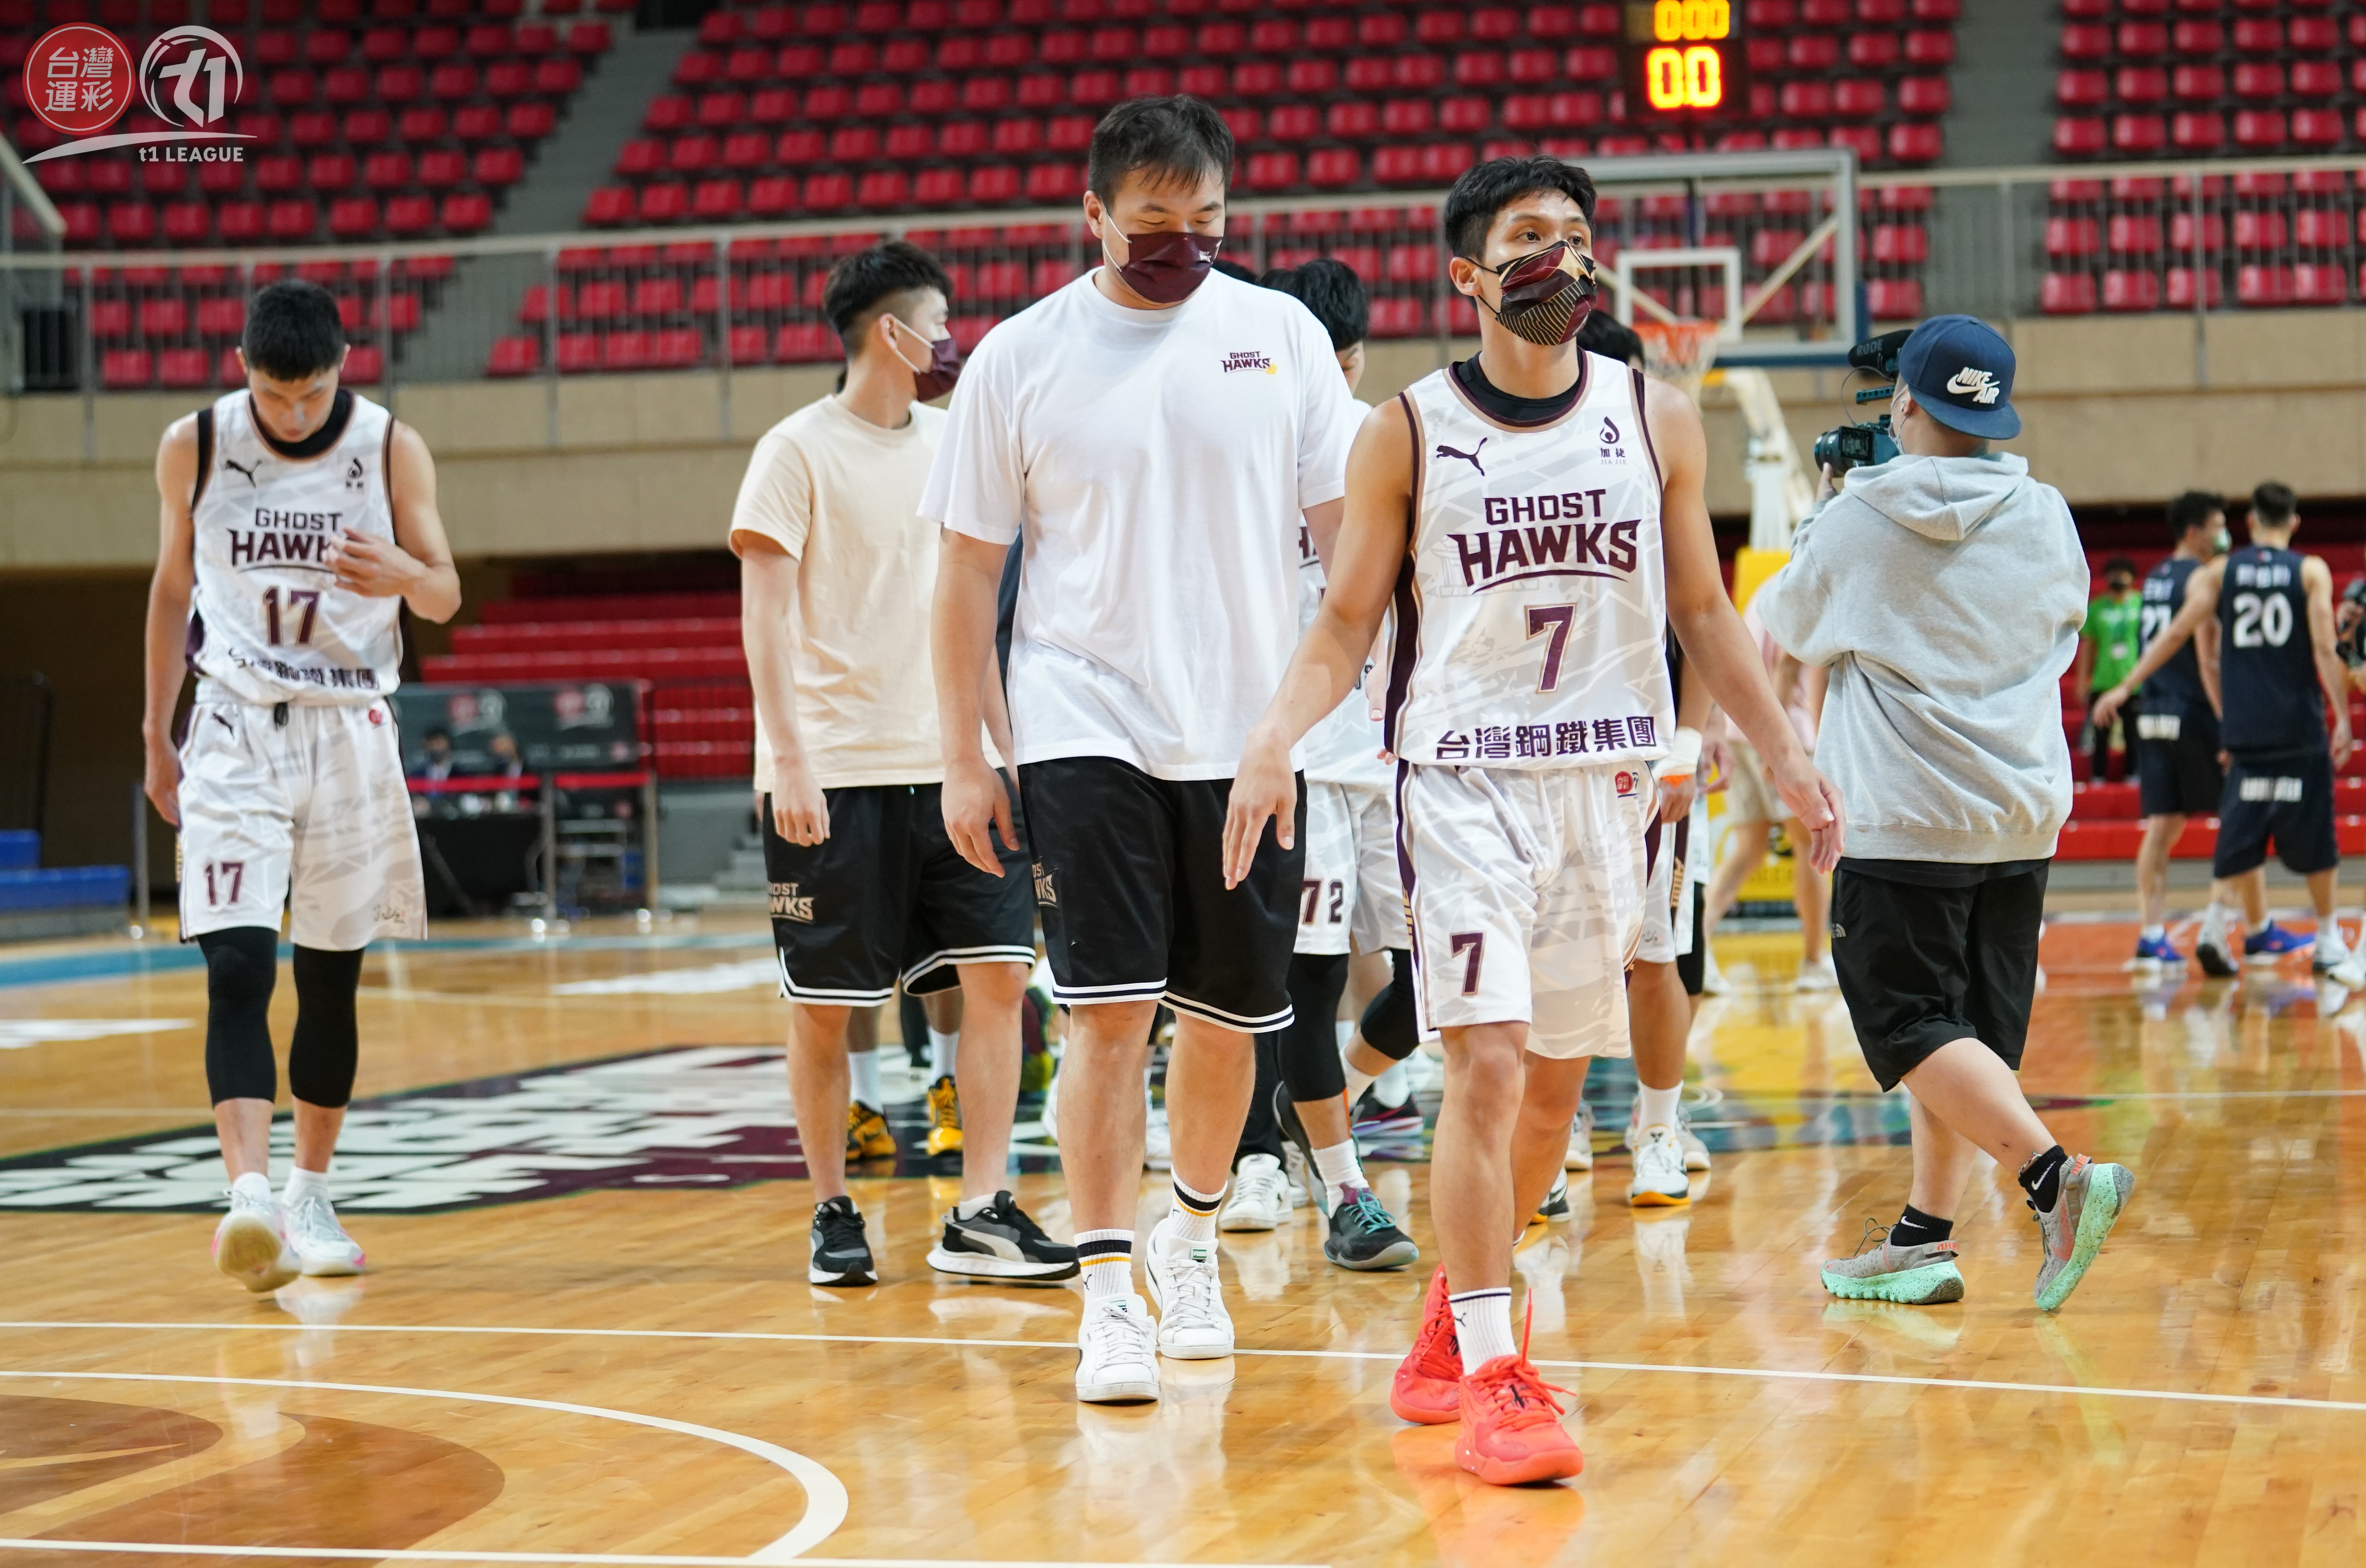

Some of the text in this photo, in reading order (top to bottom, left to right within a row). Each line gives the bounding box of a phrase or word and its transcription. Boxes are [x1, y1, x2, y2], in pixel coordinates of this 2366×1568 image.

[1220, 358, 1271, 373] HAWKS
[1956, 367, 1993, 386] NIKE
[1973, 386, 2000, 404] AIR
[255, 508, 343, 532] GHOST
[1484, 489, 1606, 525] GHOST
[1446, 519, 1642, 587] HAWKS
[263, 585, 322, 647] 17
[2233, 592, 2293, 649] 20
[1524, 602, 1577, 694] 7
[1436, 716, 1657, 760] 台灣鋼鐵集團
[204, 861, 246, 906] 17
[769, 882, 799, 896] OST
[1301, 878, 1344, 925] 72
[770, 896, 814, 921] WKS
[1450, 931, 1485, 996] 7
